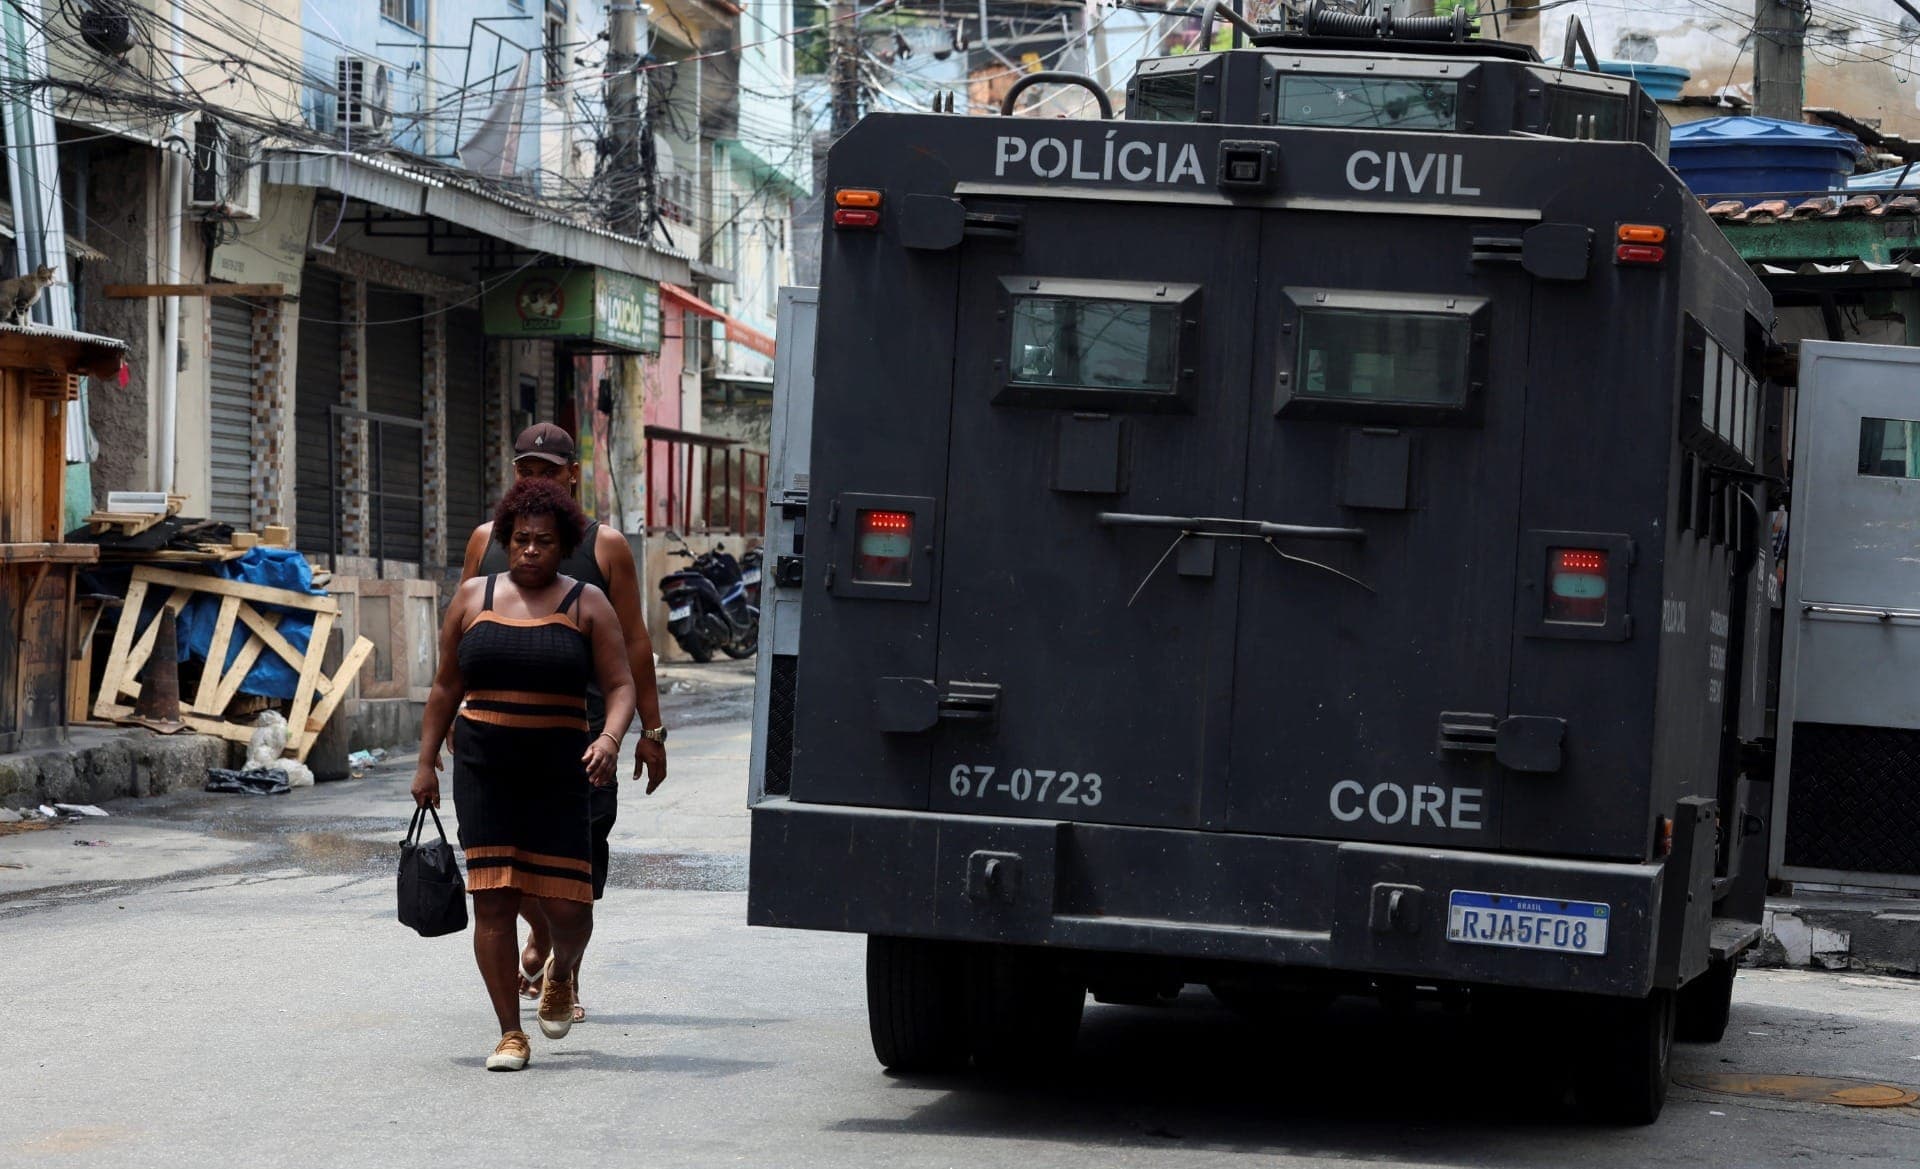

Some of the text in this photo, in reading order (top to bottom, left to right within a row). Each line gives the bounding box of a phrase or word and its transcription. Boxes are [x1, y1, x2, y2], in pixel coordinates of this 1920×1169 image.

[994, 130, 1481, 196] POLÍCIA CIVIL
[949, 763, 1103, 806] 67-0723
[1329, 780, 1483, 830] CORE
[1516, 902, 1543, 912] BRASIL
[1462, 910, 1588, 949] RJA5F08
